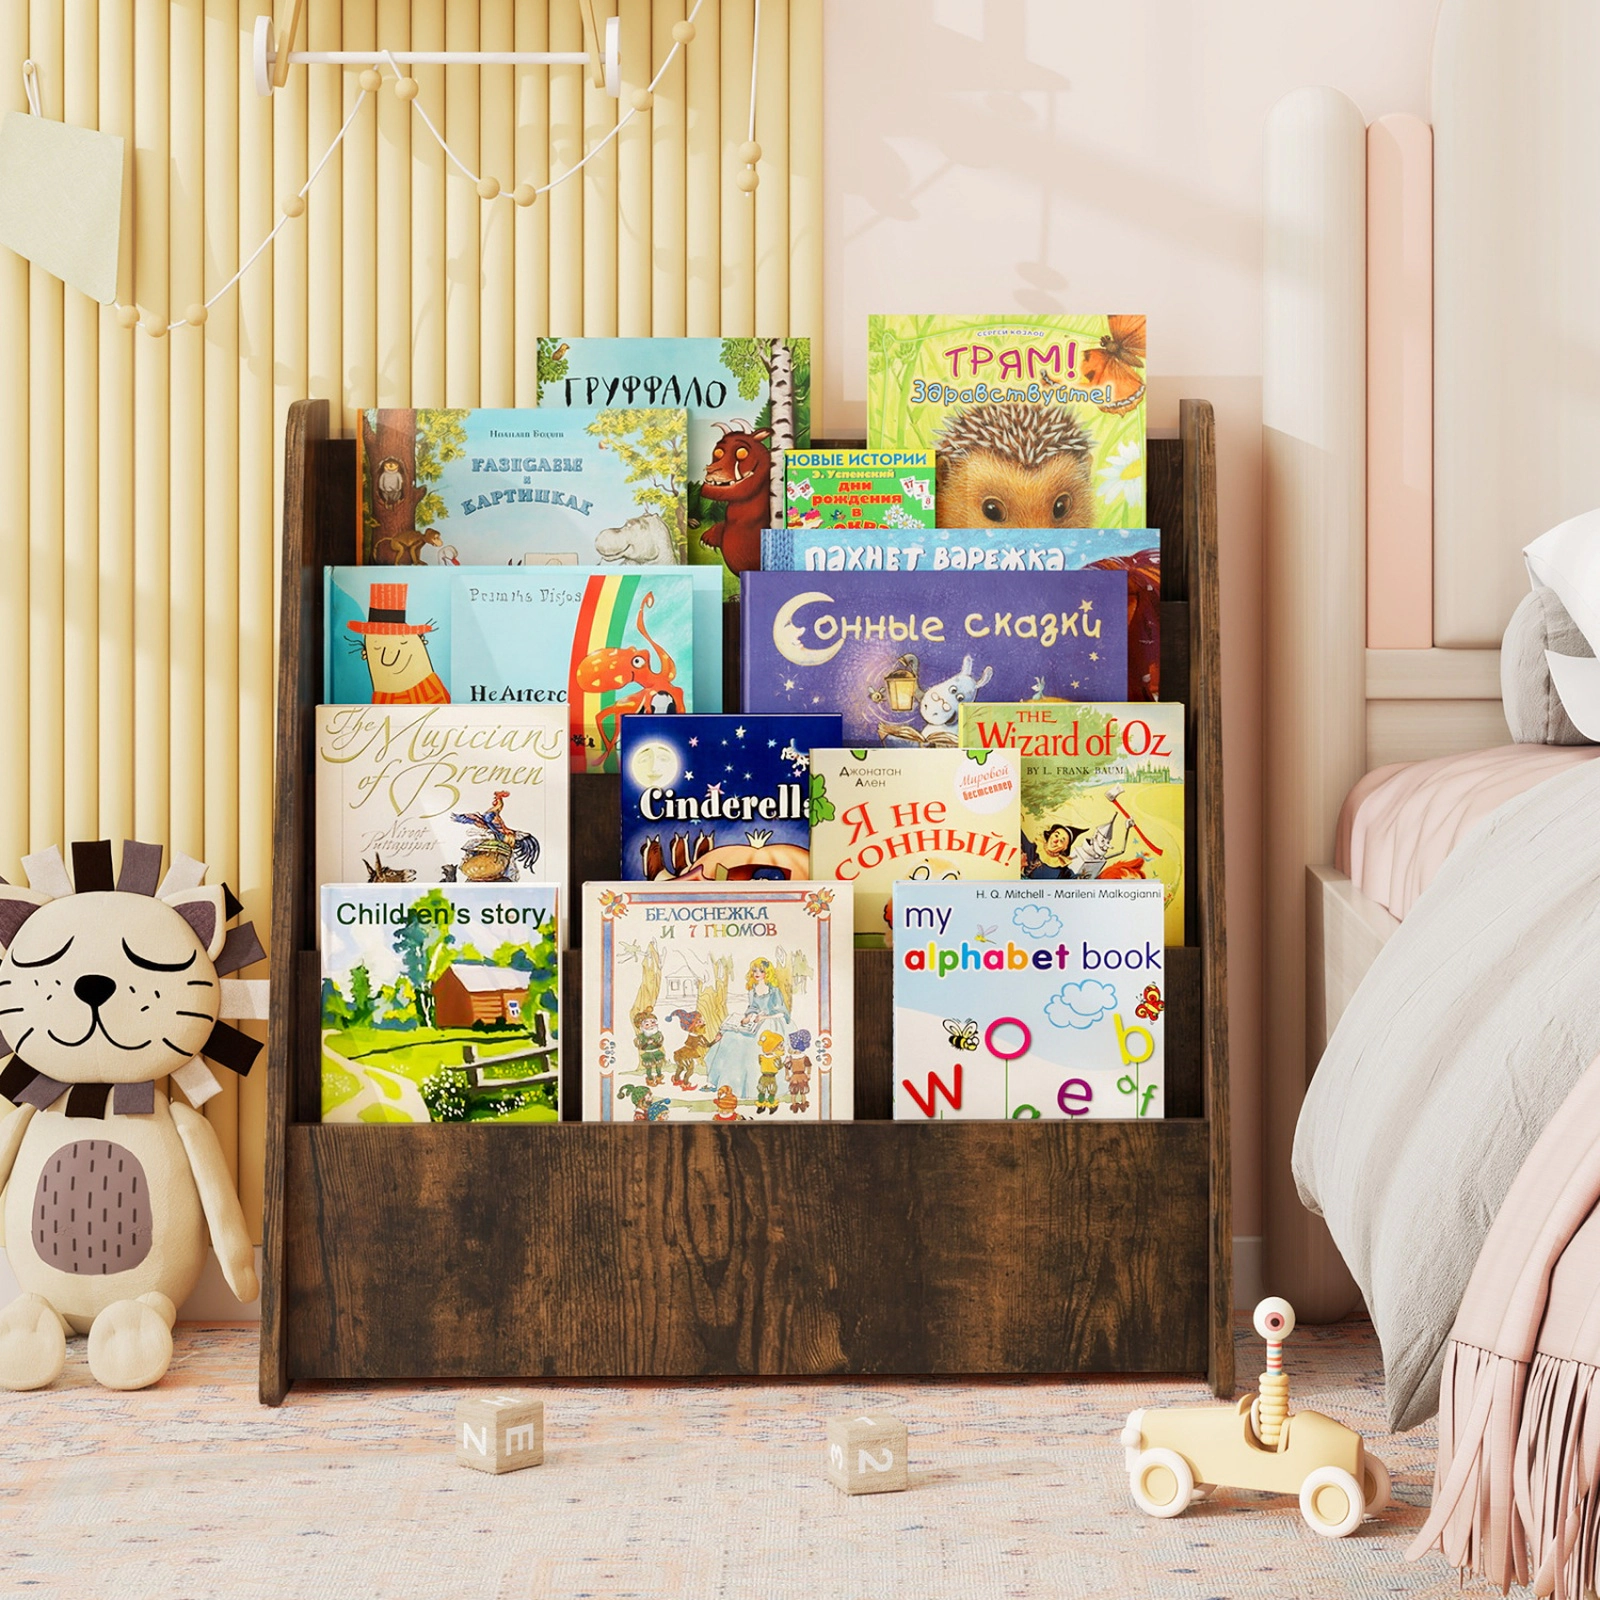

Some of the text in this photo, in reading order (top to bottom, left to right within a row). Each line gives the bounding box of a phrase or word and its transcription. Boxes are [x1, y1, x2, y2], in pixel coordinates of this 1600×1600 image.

[945, 342, 1076, 379] ТРЯМ!
[564, 374, 728, 408] ГРУФФАЛО
[911, 380, 1111, 406] Здравствуйте!
[787, 453, 927, 466] НОВЫЕ ИСТОРИИ
[812, 469, 896, 479] Э. Успенский
[838, 481, 872, 493] дни
[812, 494, 902, 507] рождения
[964, 610, 1101, 647] сказки
[1016, 711, 1057, 723] THE
[321, 707, 563, 763] The Musicians
[976, 718, 1172, 757] Wizard of Oz
[839, 766, 902, 777] Джонатан
[855, 778, 886, 787] Ален
[1027, 766, 1124, 775] BY L. FRANK BAUM
[349, 752, 543, 819] of Bremen
[841, 801, 946, 846] Я не
[835, 829, 1018, 880] сонный!
[976, 890, 987, 899] H.
[990, 890, 1001, 899] Q.
[1005, 889, 1044, 899] Mitchell
[1055, 889, 1096, 899] Marileni
[1099, 889, 1162, 901] Malkogianni
[336, 903, 546, 929] Children's story
[645, 906, 769, 922] БЕЛОСНЕЖКА
[905, 907, 952, 934] my
[660, 923, 777, 939] И 7 ГНОМОВ
[905, 942, 1162, 977] alphabet book
[463, 1422, 487, 1456] N
